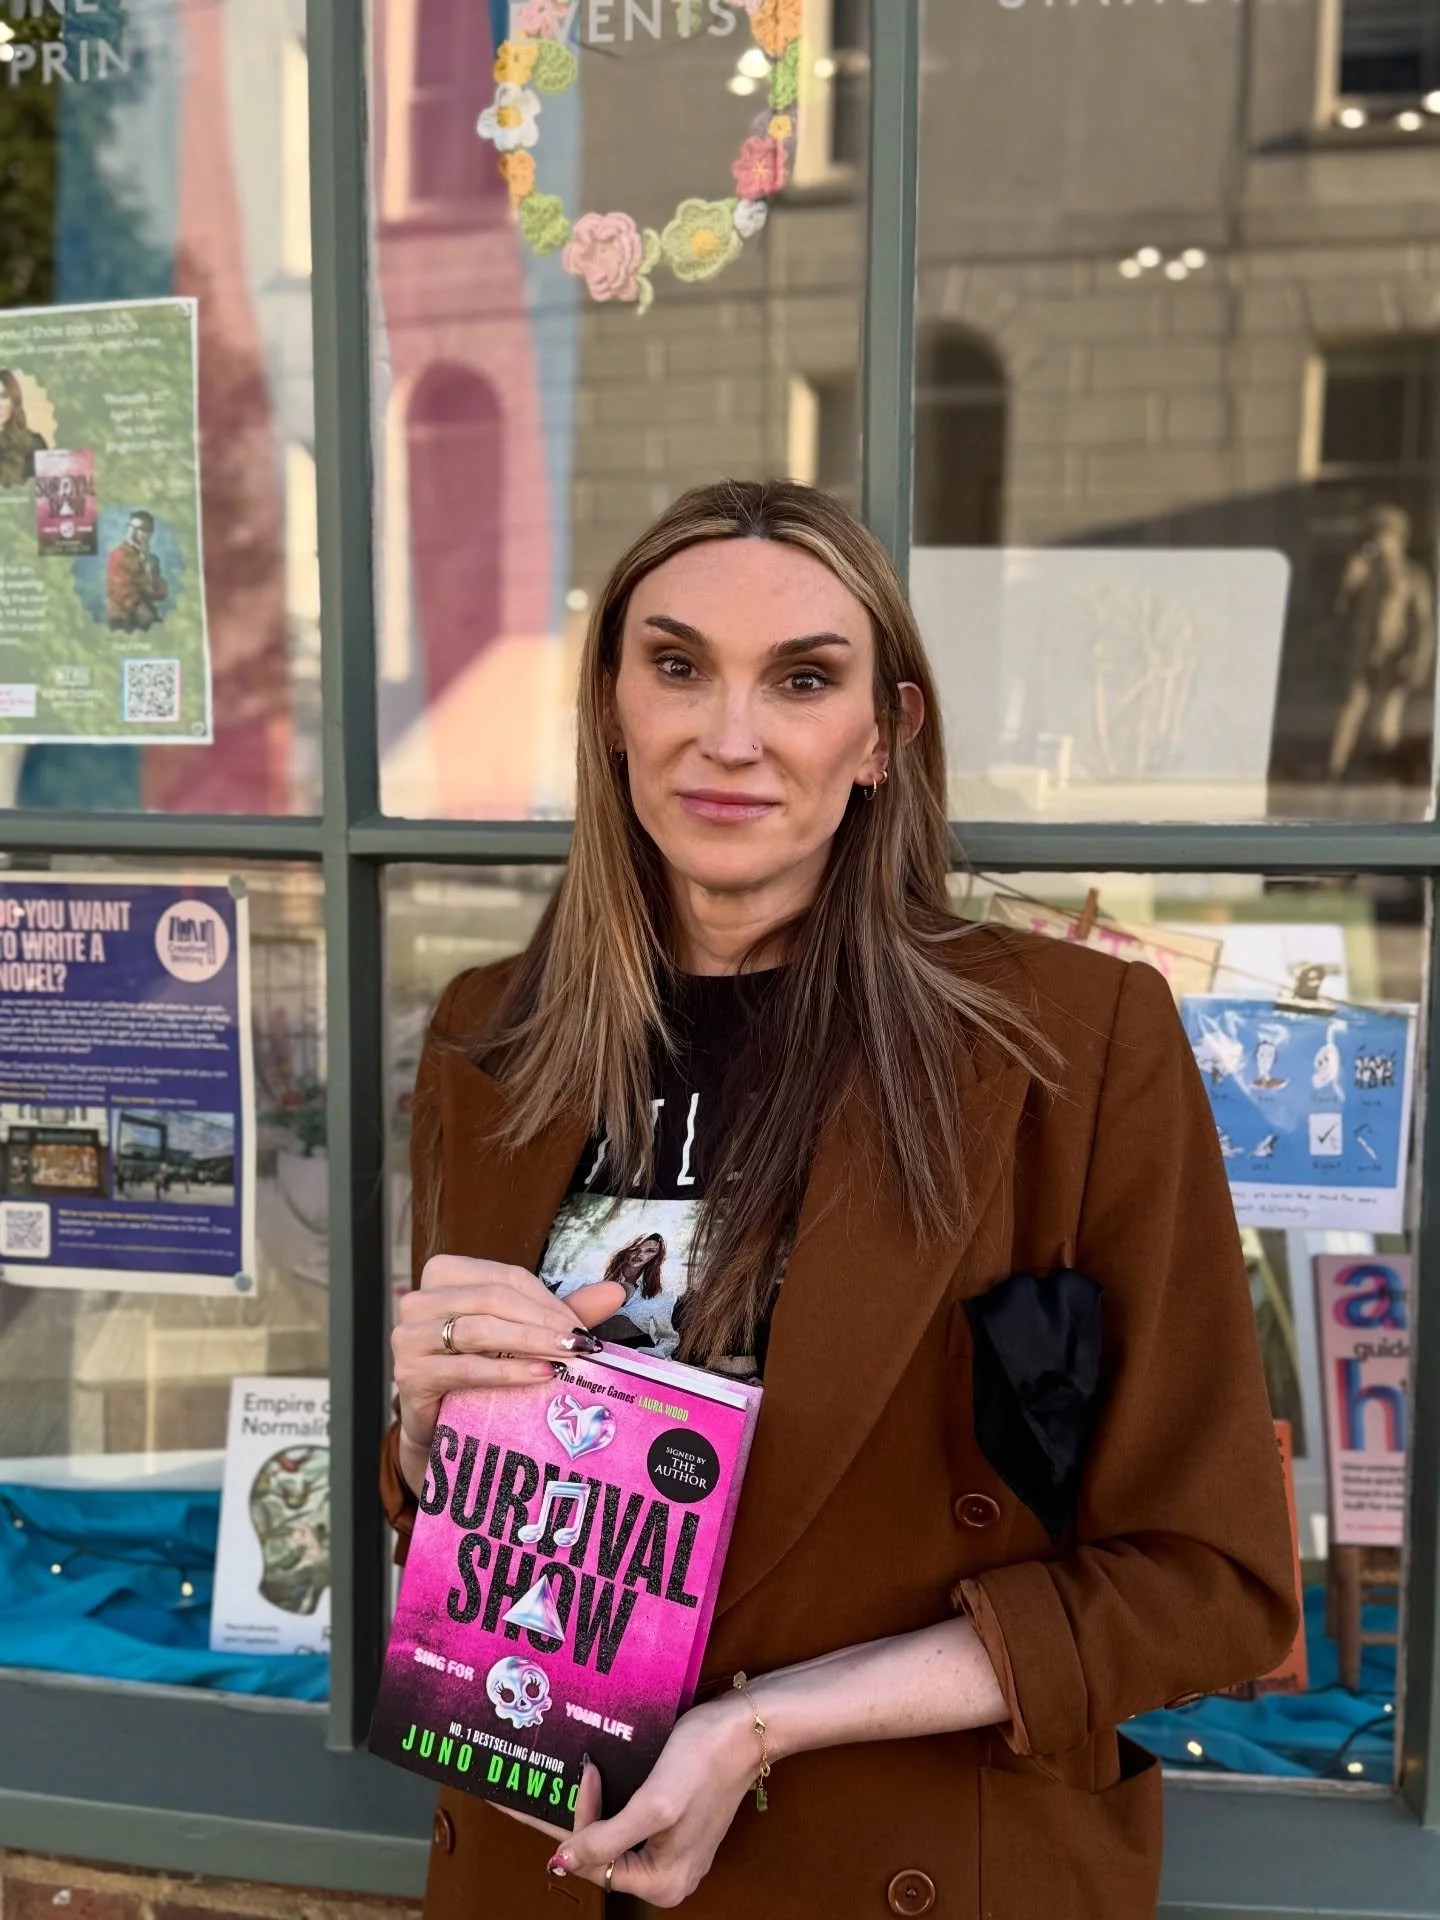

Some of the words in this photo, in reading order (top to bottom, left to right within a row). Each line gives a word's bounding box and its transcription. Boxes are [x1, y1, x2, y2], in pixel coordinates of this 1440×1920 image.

[24, 898, 65, 930] YOU
[69, 900, 131, 931] WANT
[0, 931, 17, 961] O
[22, 931, 87, 962] WRITE
[90, 932, 106, 963] A
[243, 1392, 316, 1417] Empire
[559, 1371, 577, 1384] The
[576, 1375, 606, 1393] Hunger
[639, 1395, 663, 1413] LAURA
[665, 1405, 689, 1422] WOOD
[666, 1446, 695, 1462] SIGNED
[696, 1457, 706, 1465] BY
[672, 1457, 696, 1474] THE
[654, 1464, 707, 1490] AUTHOR
[447, 1532, 639, 1676] SHOW
[414, 1647, 447, 1671] SING
[446, 1660, 475, 1682] FOR
[566, 1701, 602, 1729] YOUR
[603, 1716, 634, 1742] LIFE
[449, 1721, 463, 1739] NO.
[466, 1728, 472, 1741] 1
[473, 1730, 528, 1761] BESTSELLING
[529, 1750, 565, 1774] AUTHOR
[402, 1723, 473, 1773] JUNO
[487, 1754, 580, 1813] DAWSO
